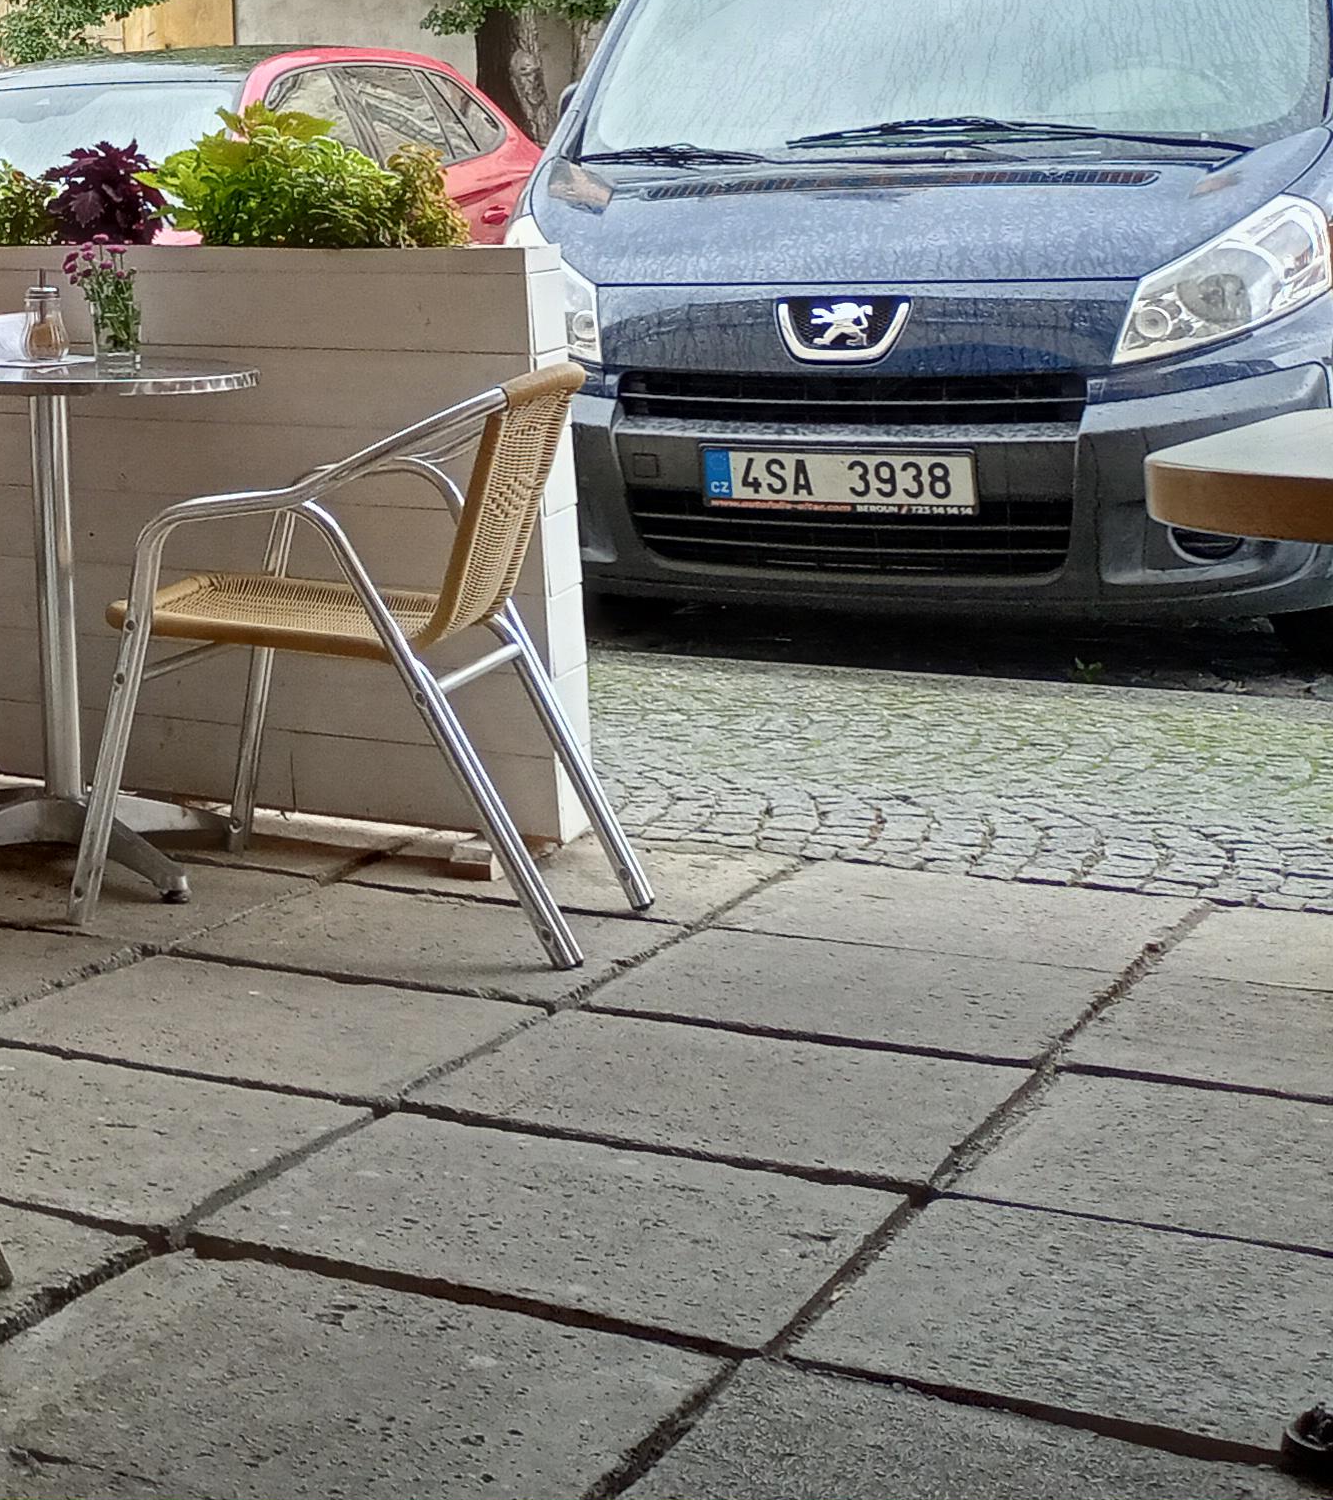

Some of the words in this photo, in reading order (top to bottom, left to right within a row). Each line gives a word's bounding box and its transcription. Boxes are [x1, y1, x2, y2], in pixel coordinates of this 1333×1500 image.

[741, 457, 814, 497] 4SA
[847, 460, 952, 500] 3938
[710, 481, 730, 493] CZ
[856, 504, 899, 514] BEROUN
